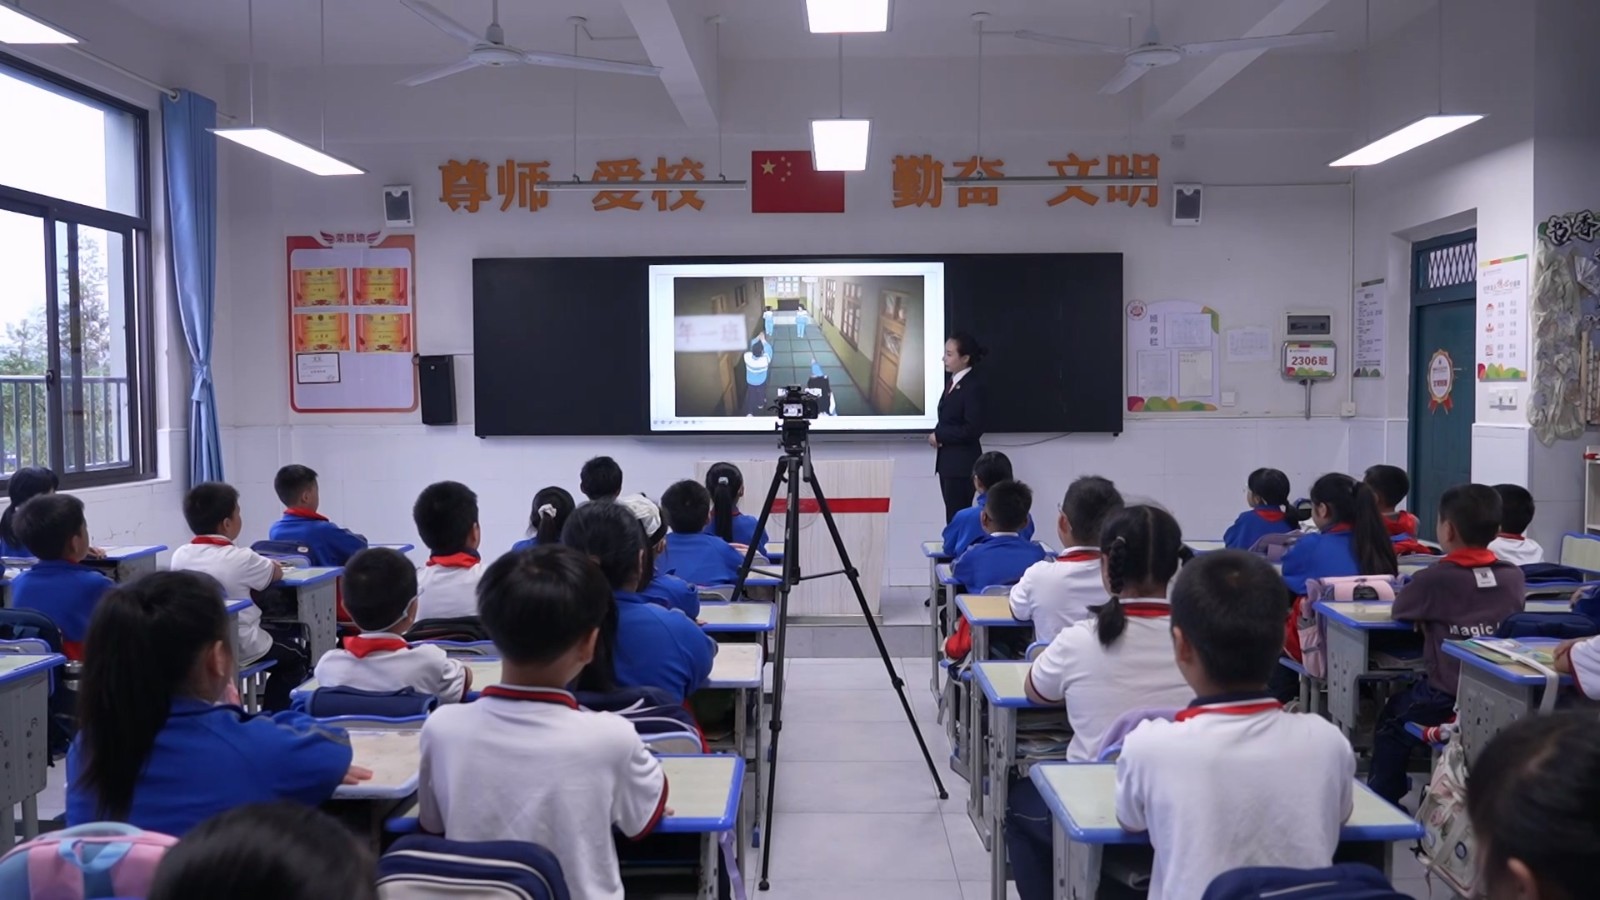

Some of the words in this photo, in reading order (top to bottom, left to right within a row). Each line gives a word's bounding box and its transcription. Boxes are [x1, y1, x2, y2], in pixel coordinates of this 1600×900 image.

[438, 158, 551, 214] 尊师
[590, 156, 705, 213] 爱校
[891, 153, 1004, 209] 勤奋
[1046, 152, 1161, 208] 文明
[1291, 356, 1328, 366] 2306班
[1449, 623, 1494, 638] Magic
